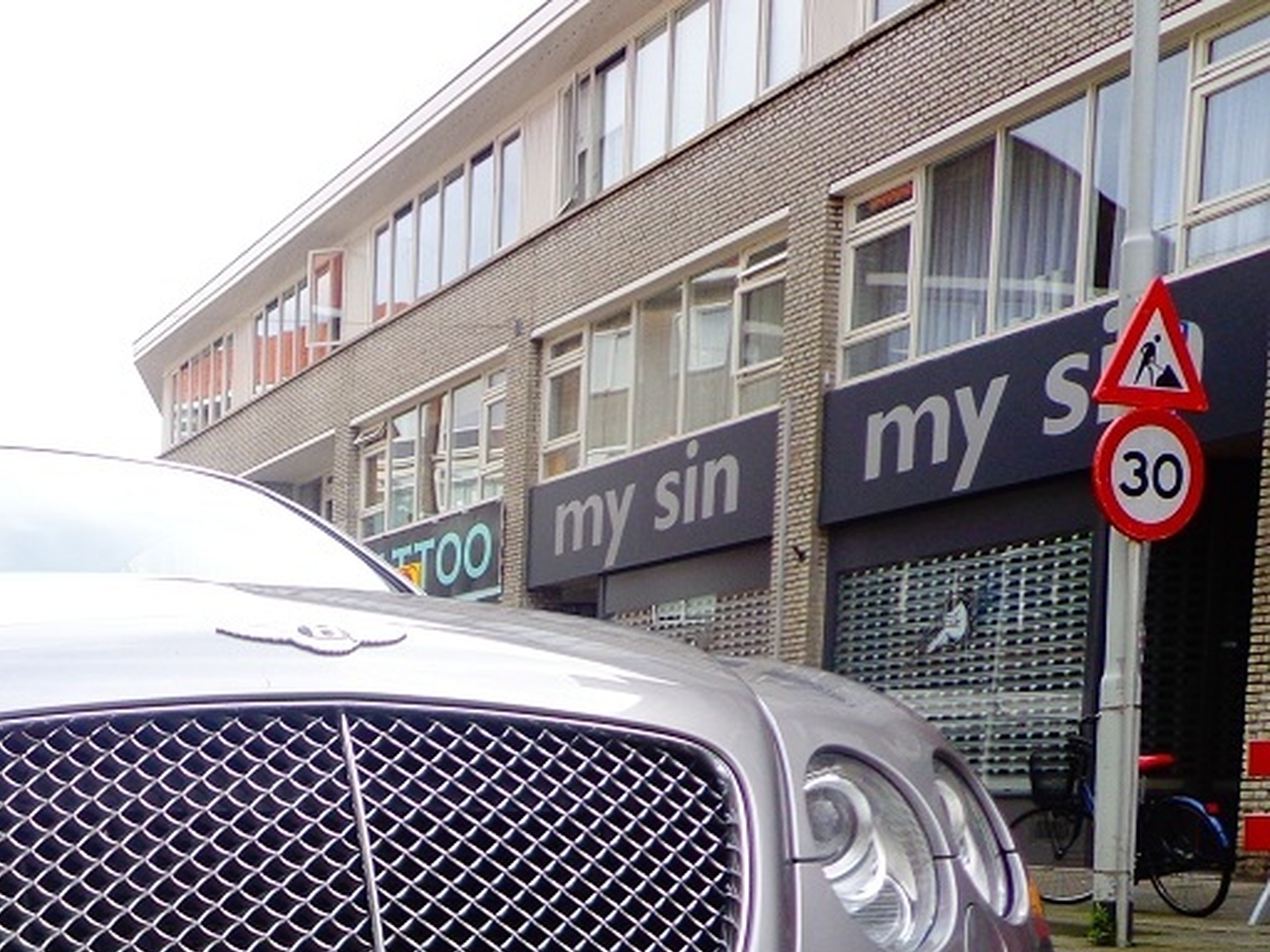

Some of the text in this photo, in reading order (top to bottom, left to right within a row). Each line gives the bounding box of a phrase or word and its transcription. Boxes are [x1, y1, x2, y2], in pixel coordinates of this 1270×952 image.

[864, 374, 1010, 492] my
[1118, 451, 1184, 499] 30
[554, 439, 740, 570] my sin
[378, 522, 492, 592] TTOO
